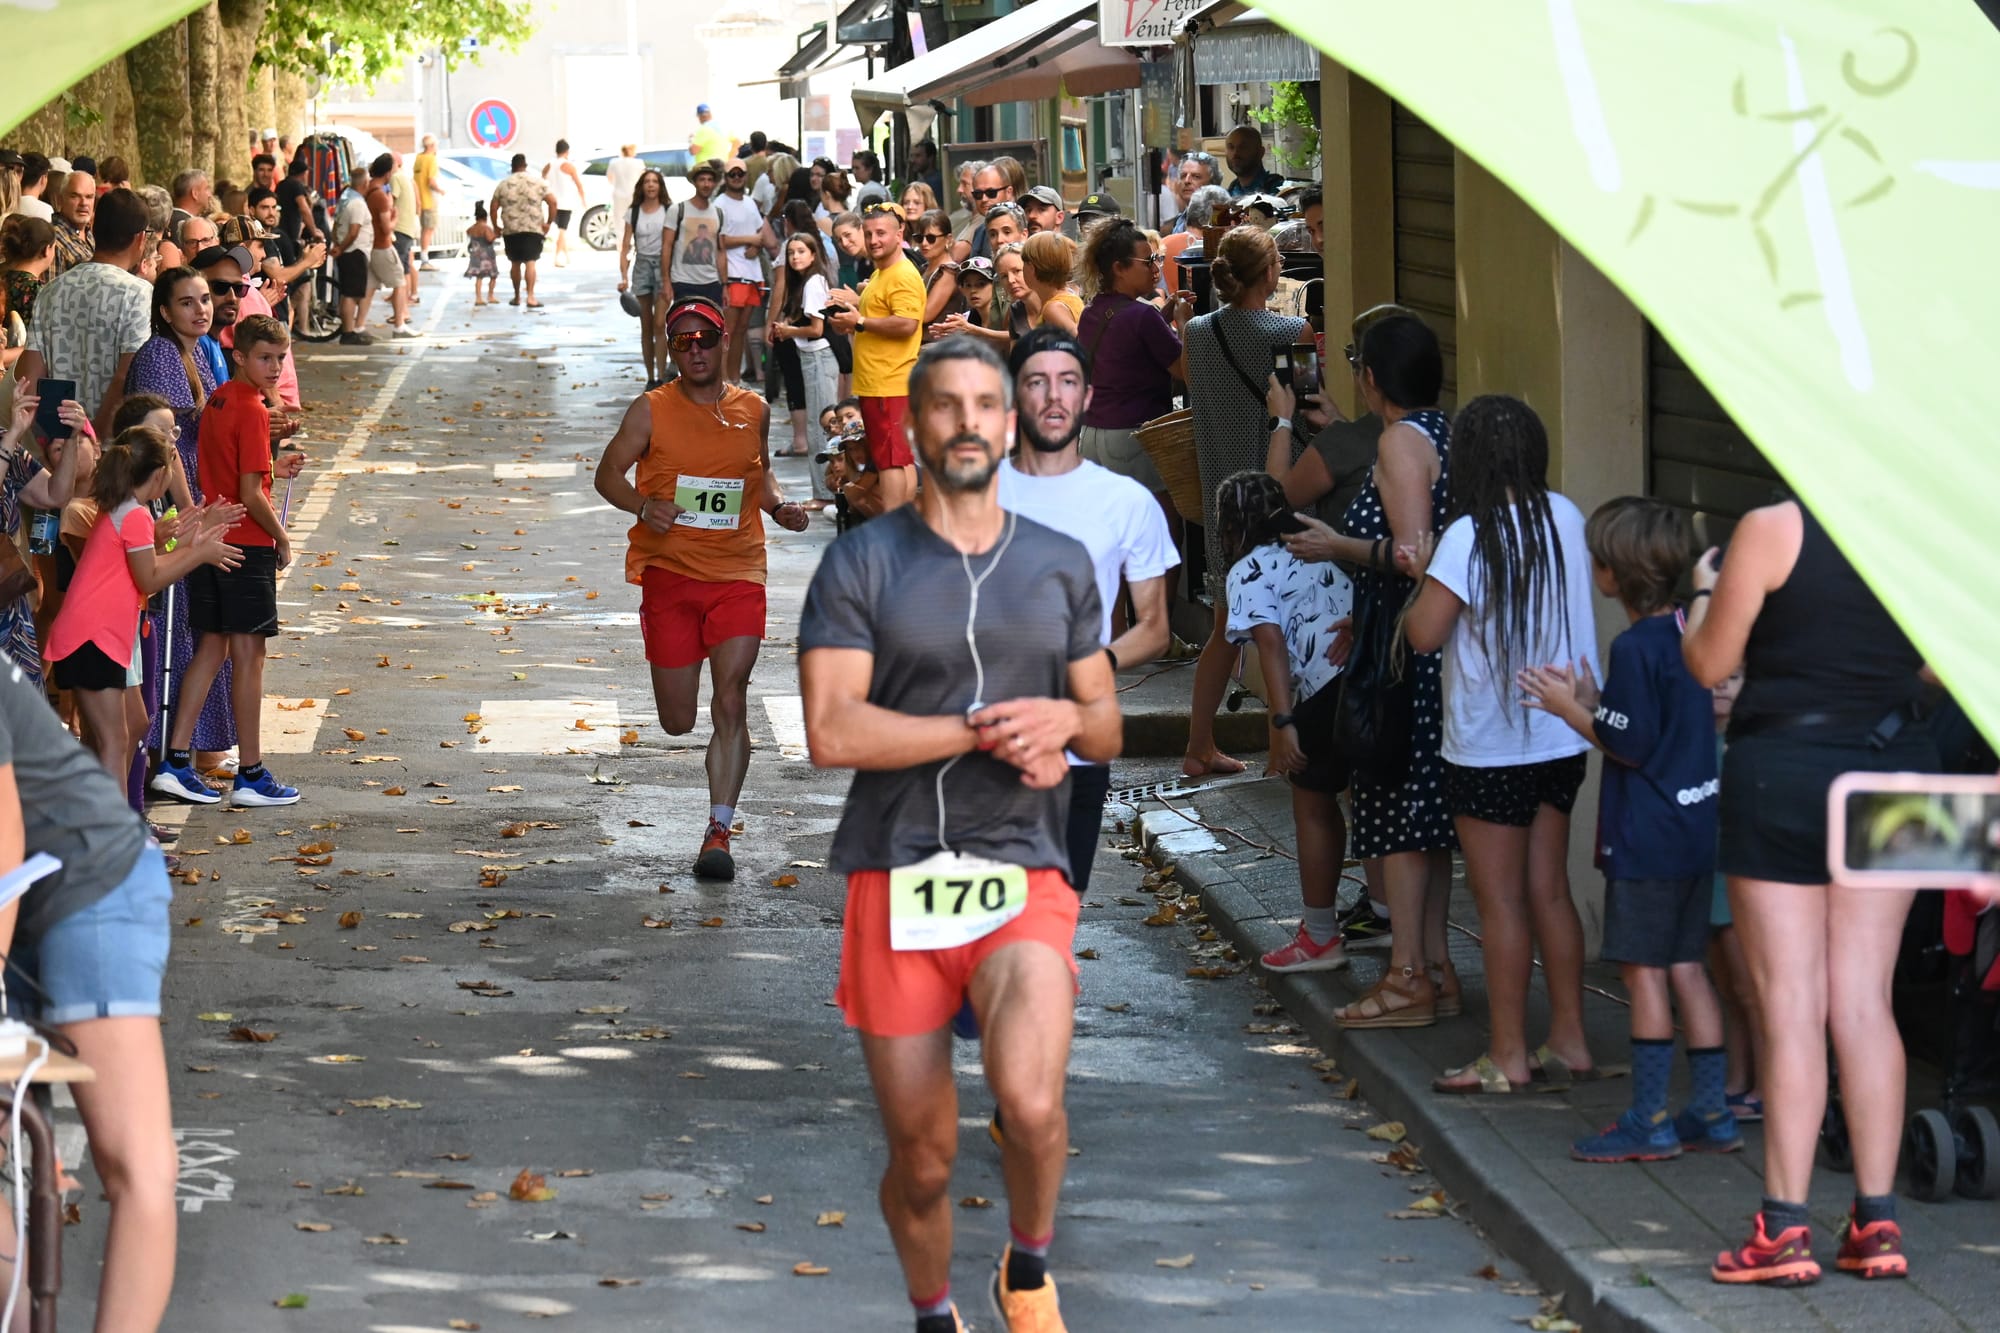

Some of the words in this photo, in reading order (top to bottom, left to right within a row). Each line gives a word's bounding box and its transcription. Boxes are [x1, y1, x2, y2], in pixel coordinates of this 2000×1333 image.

[1124, 0, 1174, 38] Vénit
[695, 491, 726, 513] 16
[913, 877, 1006, 915] 170
